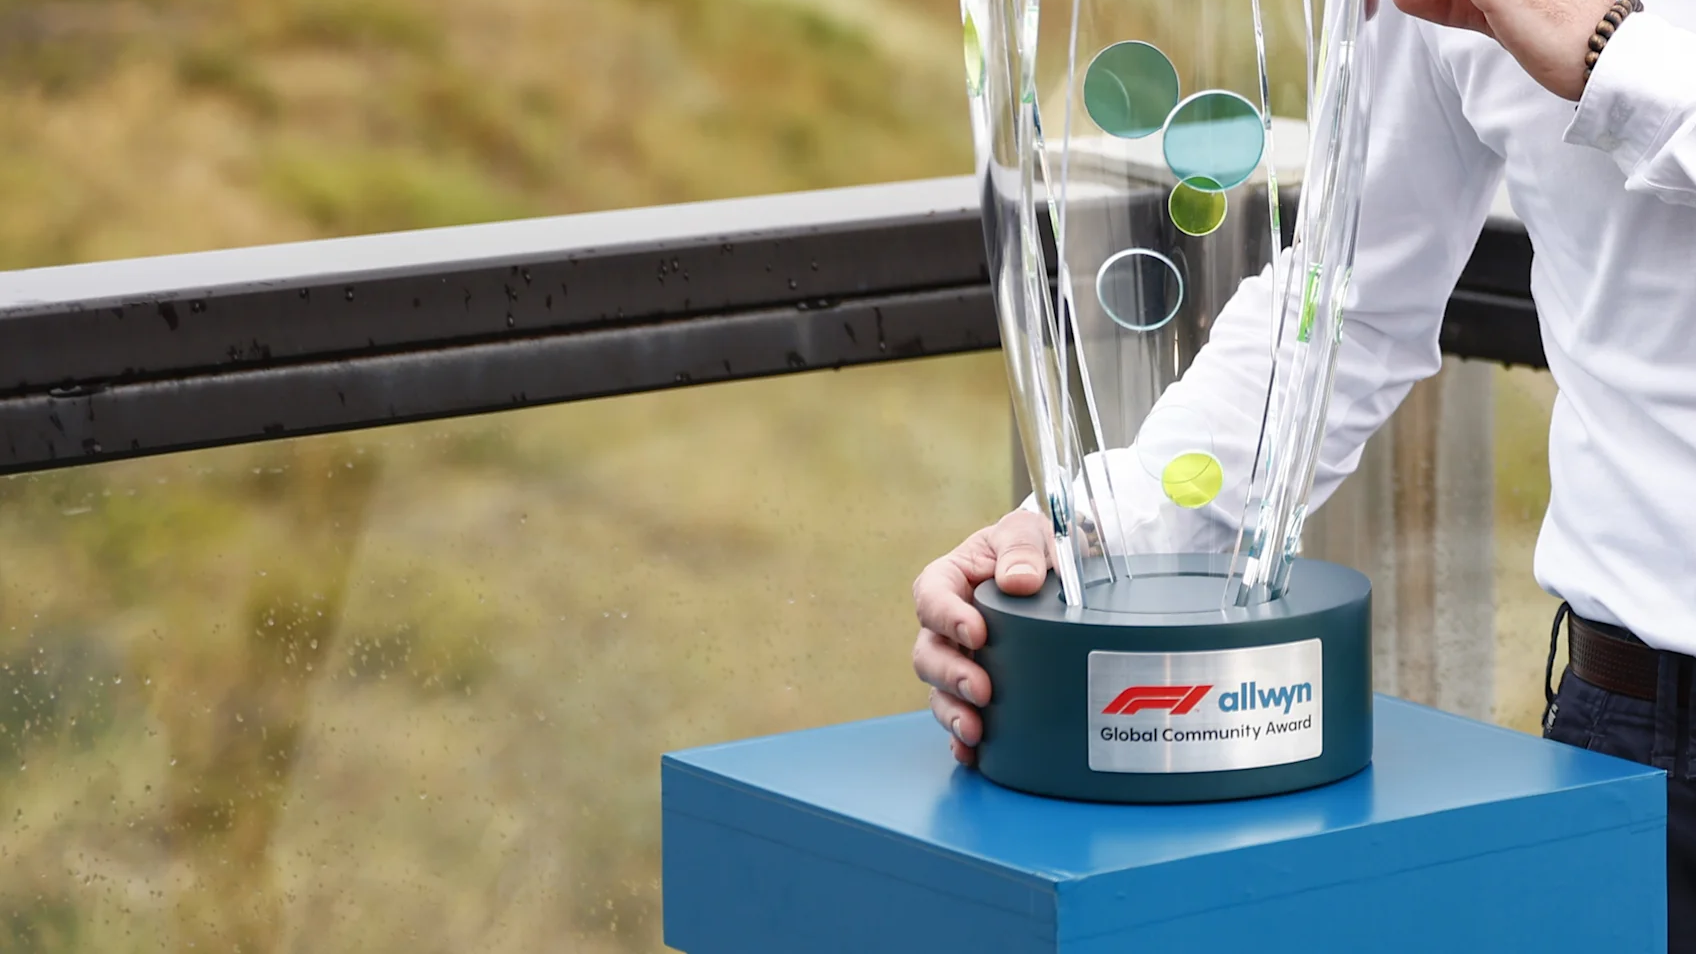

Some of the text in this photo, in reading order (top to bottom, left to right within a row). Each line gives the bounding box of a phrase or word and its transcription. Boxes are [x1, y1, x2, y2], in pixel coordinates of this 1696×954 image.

[1218, 681, 1312, 714] allwyn
[1101, 715, 1312, 742] Global Community Award
